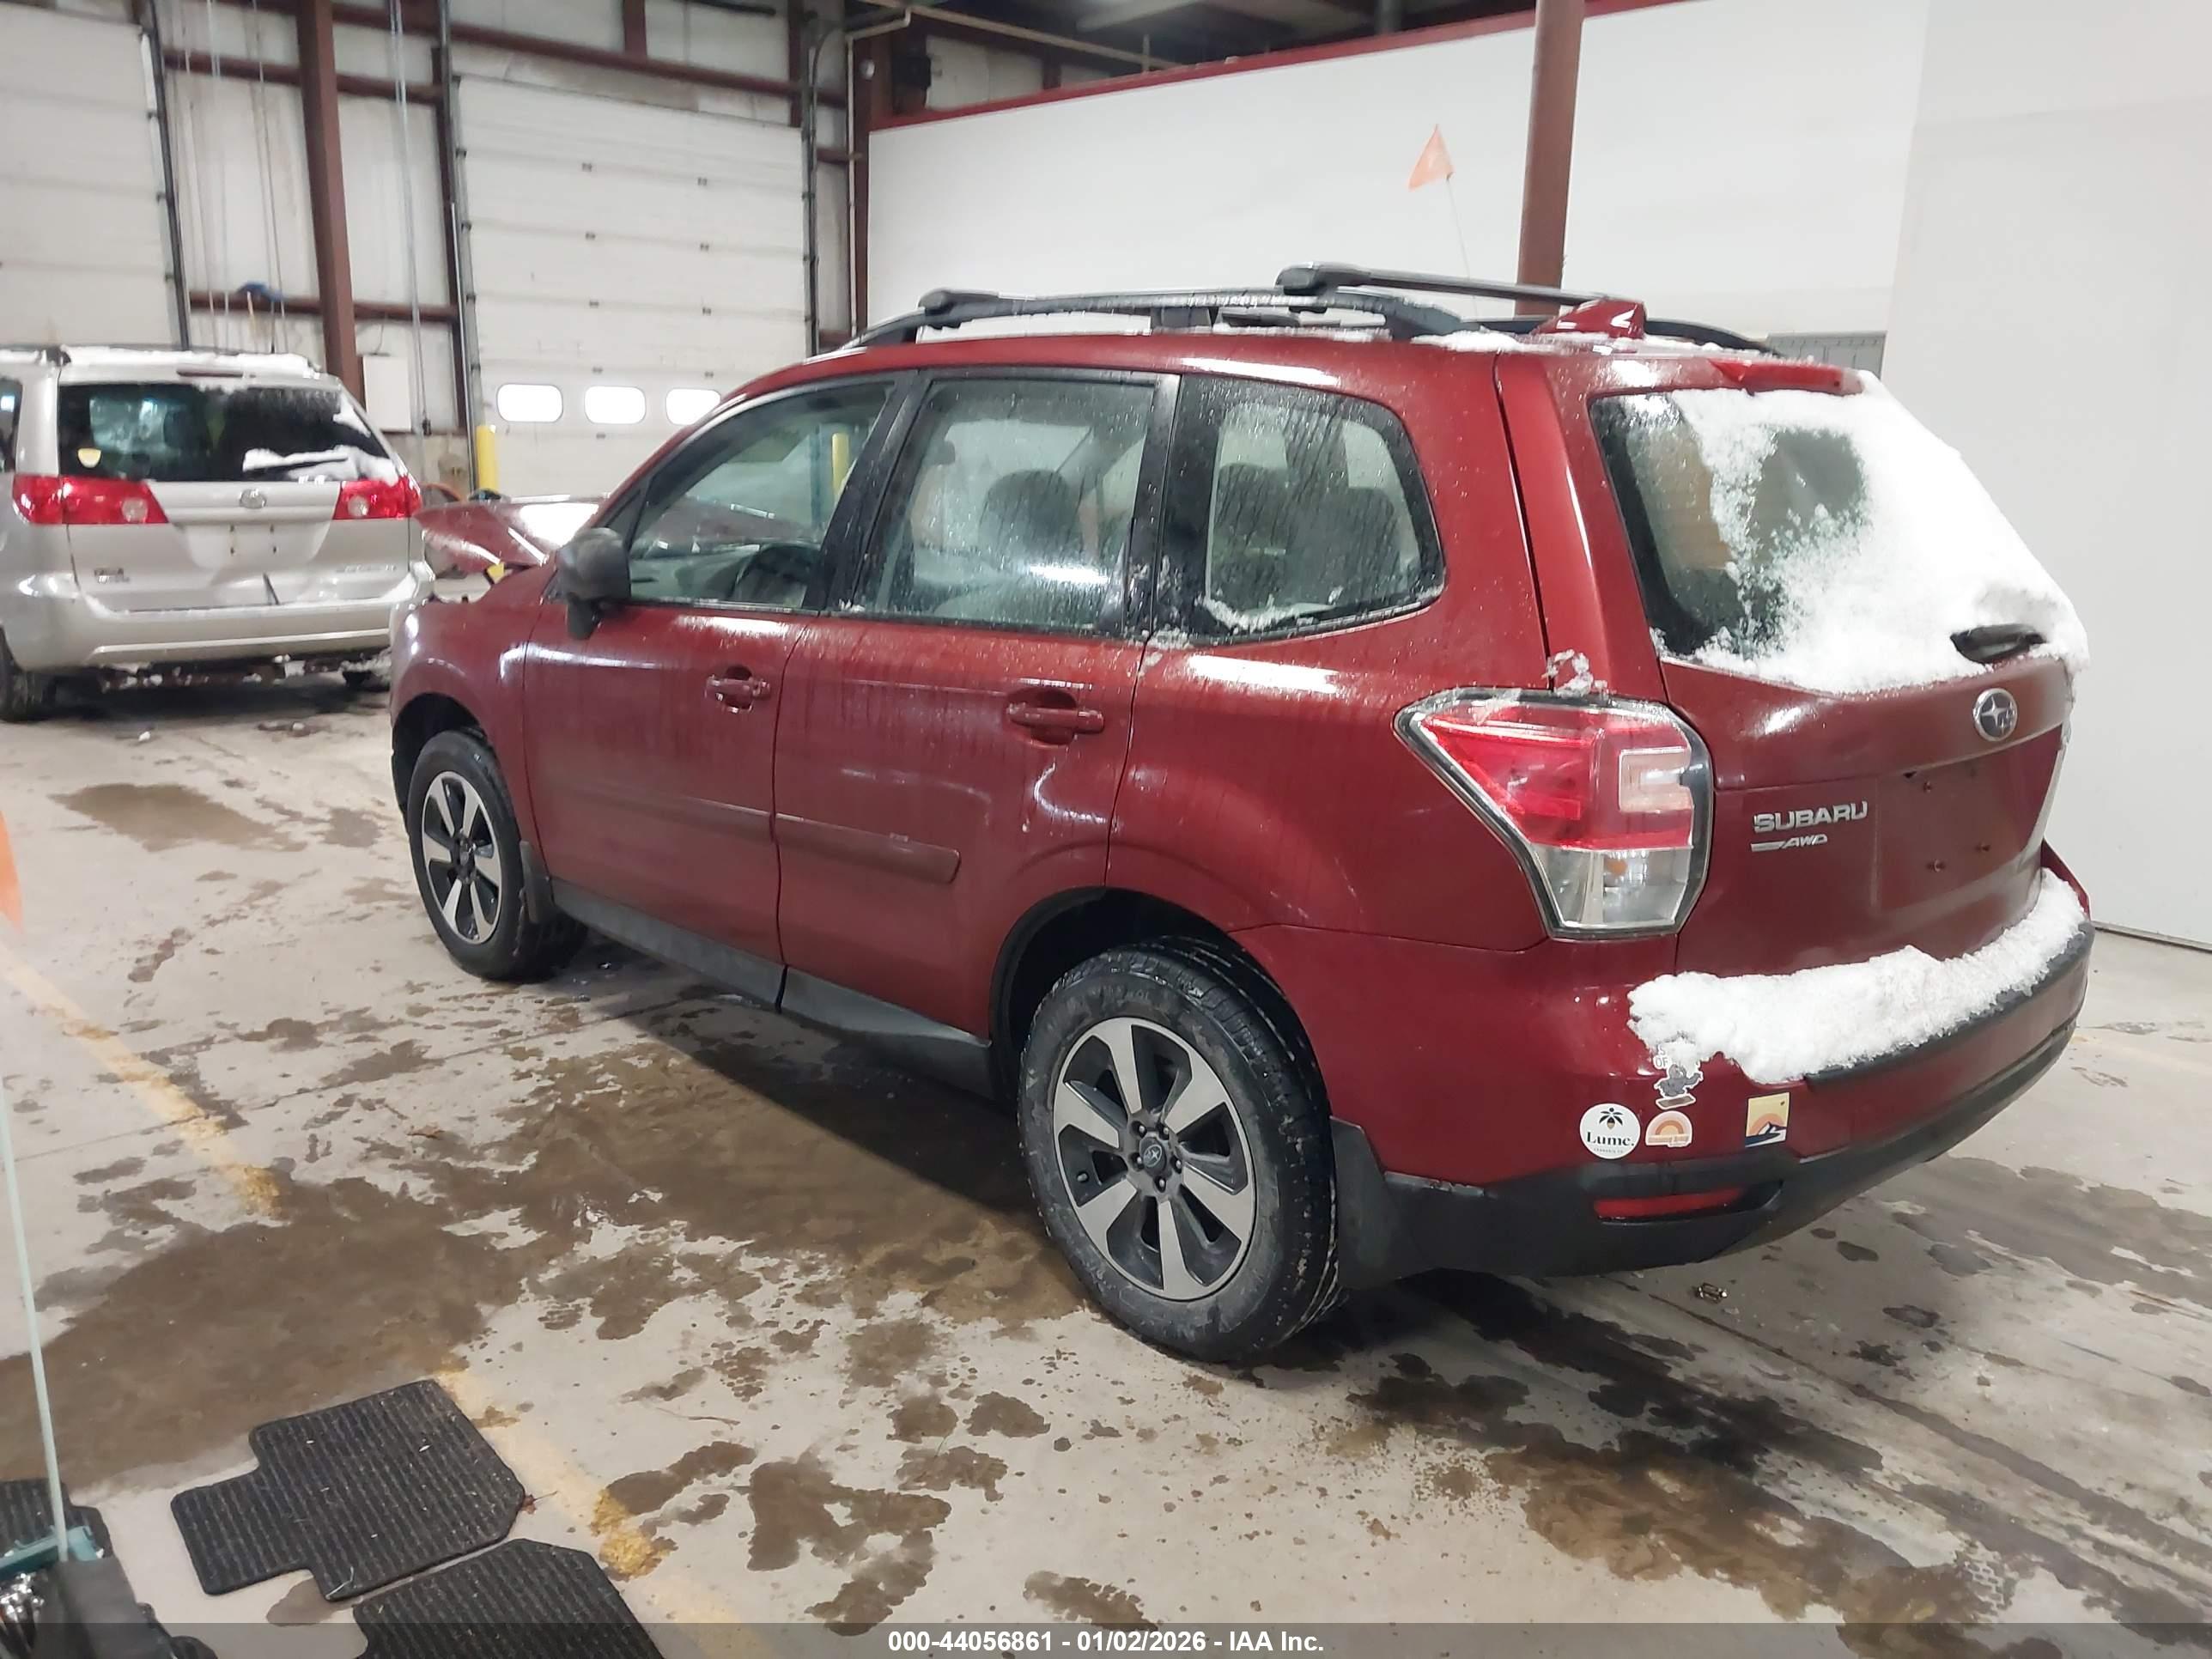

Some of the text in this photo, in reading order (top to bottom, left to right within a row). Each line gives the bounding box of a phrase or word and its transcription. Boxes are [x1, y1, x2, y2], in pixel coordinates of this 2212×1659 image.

[1753, 801, 1869, 833] SUBARU
[1782, 834, 1828, 849] AWD
[1587, 1131, 1635, 1146] Lume.
